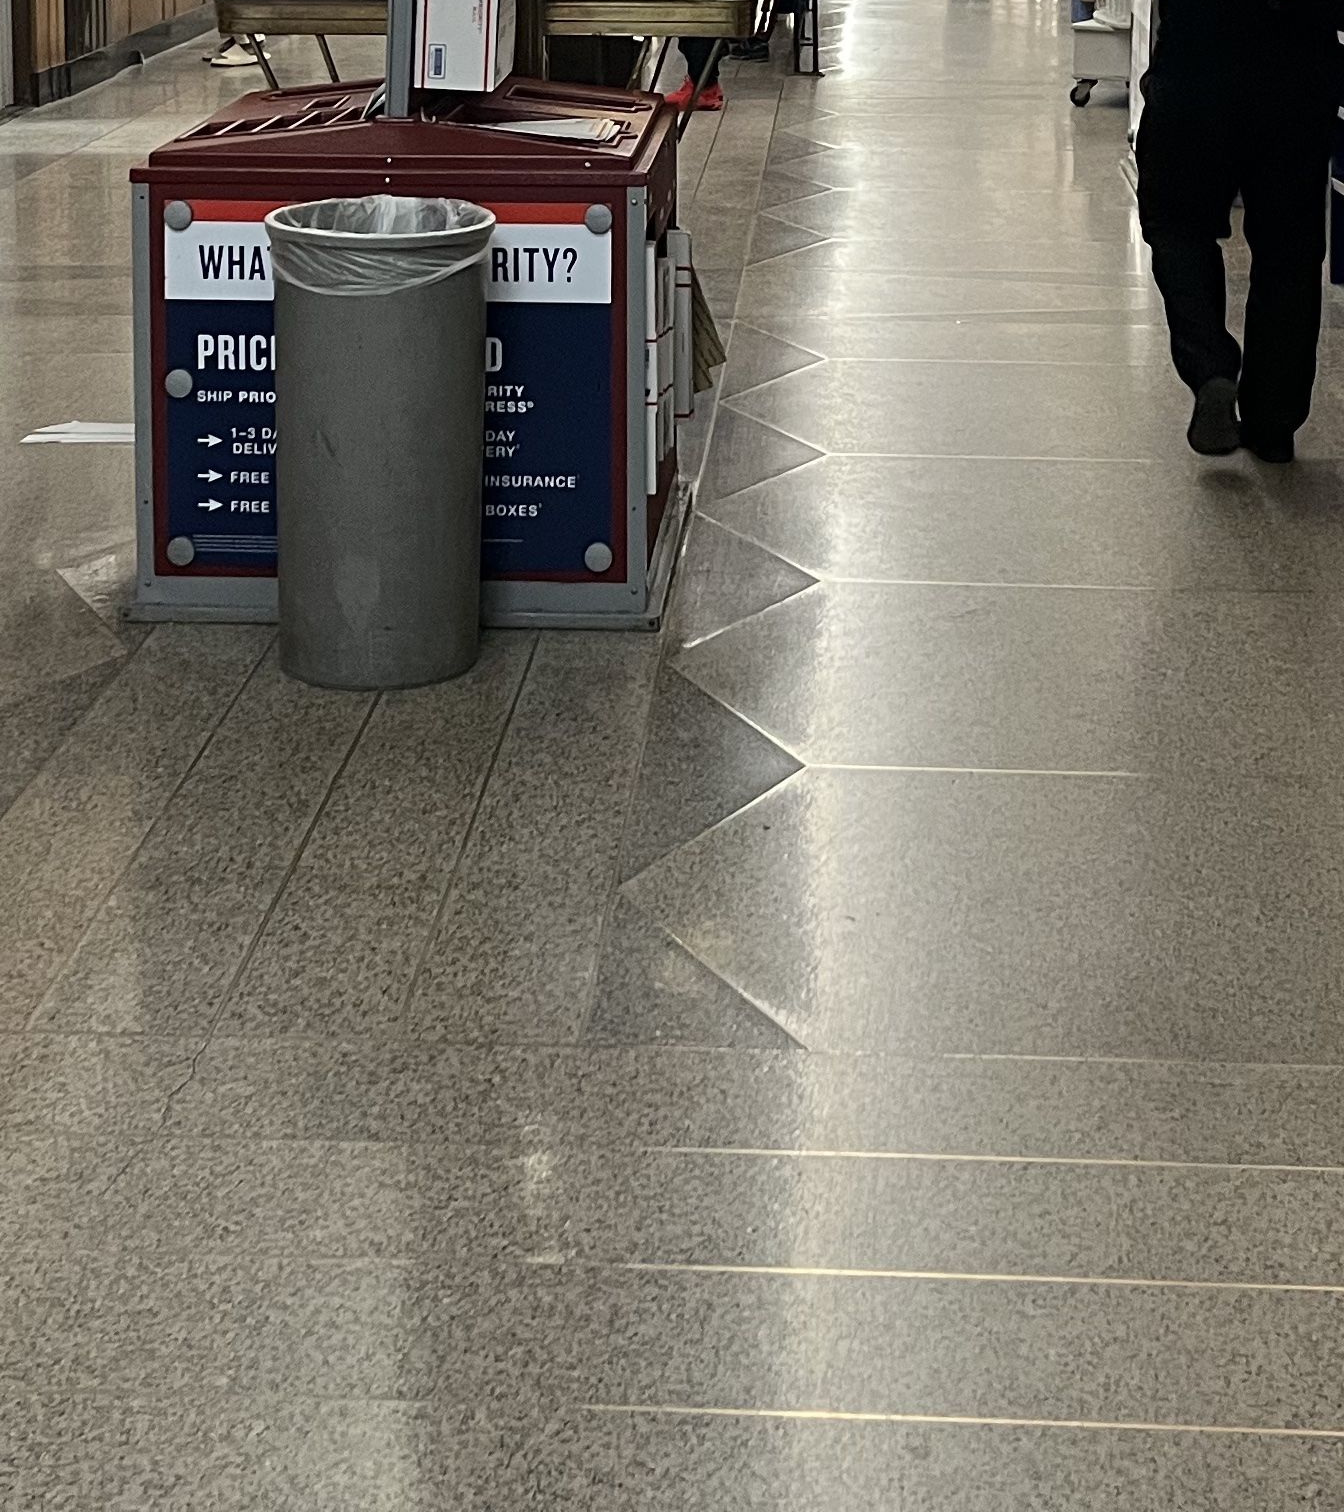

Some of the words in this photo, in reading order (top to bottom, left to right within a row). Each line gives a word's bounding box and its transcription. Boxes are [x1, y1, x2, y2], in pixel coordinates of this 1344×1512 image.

[198, 244, 271, 281] WHA
[492, 247, 578, 283] RITY?
[196, 390, 233, 403] SHIP
[487, 385, 525, 398] RITY
[485, 430, 516, 442] DAY
[230, 471, 270, 484] FREE
[230, 500, 270, 513] FREE
